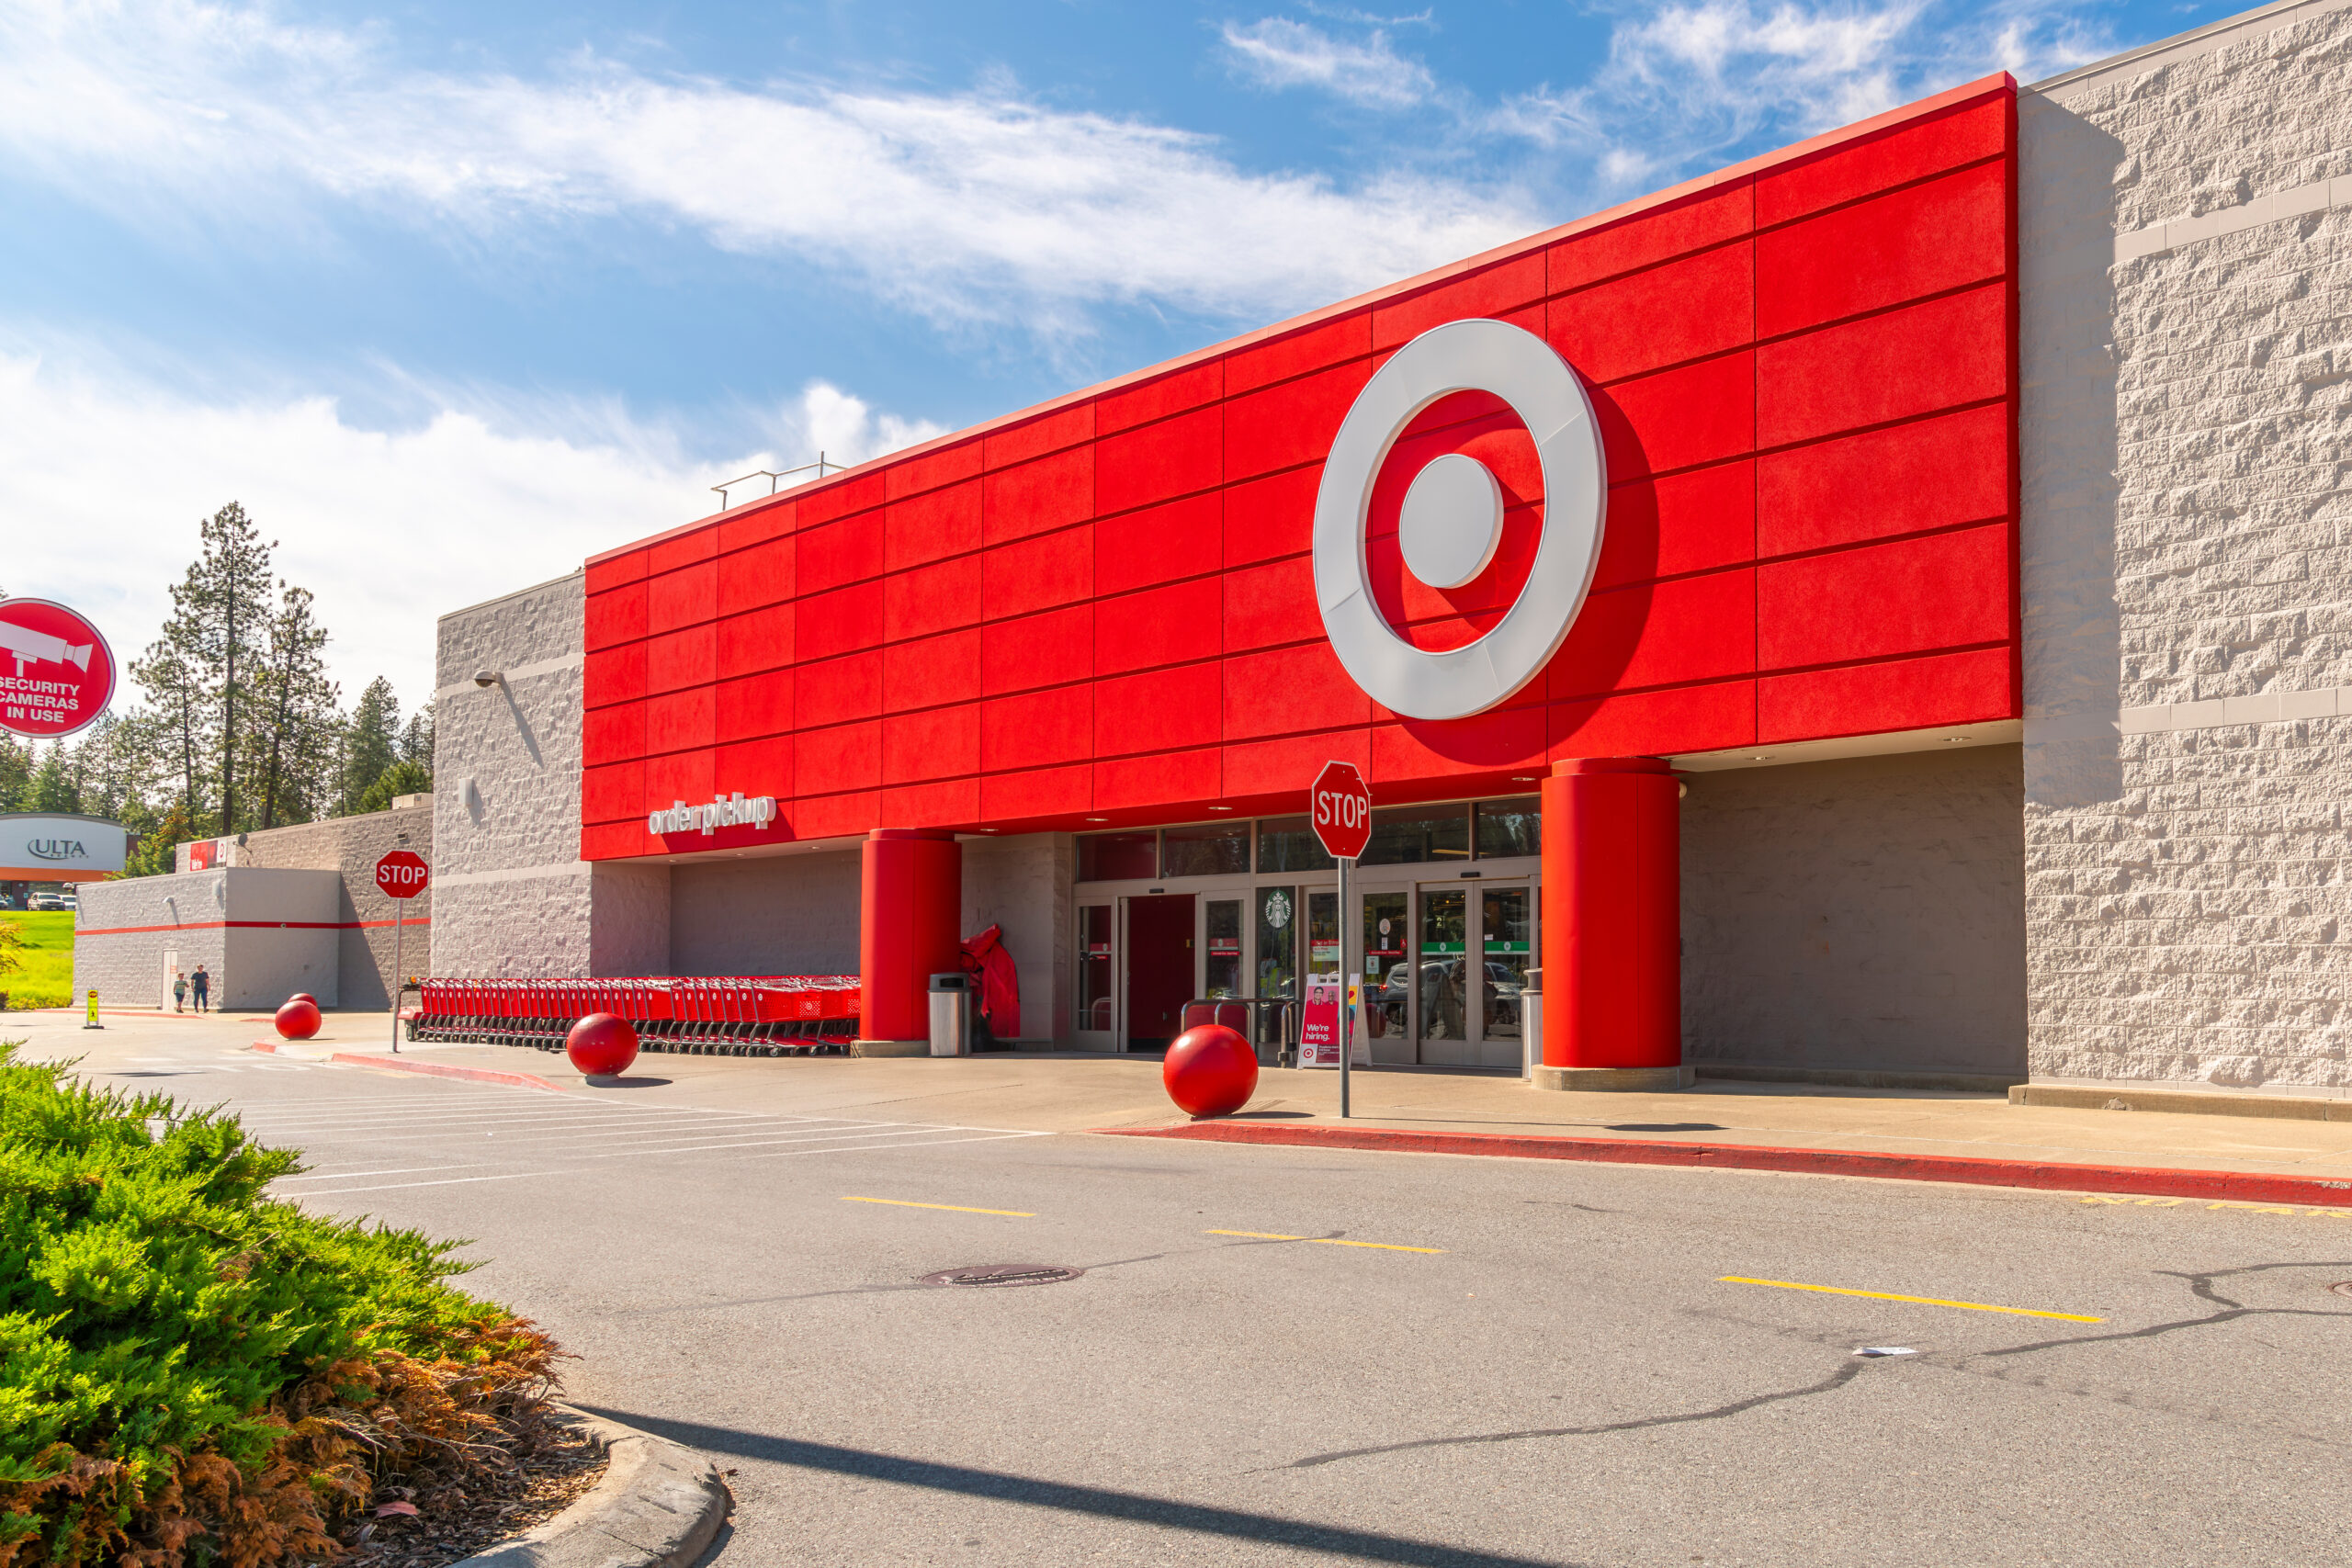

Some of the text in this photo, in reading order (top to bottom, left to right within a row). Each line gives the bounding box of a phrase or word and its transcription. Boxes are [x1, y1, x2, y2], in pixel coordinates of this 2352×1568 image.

[7, 706, 64, 723] IN USE
[649, 792, 776, 835] order pickup
[1317, 791, 1367, 829] STOP
[36, 840, 86, 854] ULTA
[379, 865, 425, 884] STOP
[1306, 1032, 1329, 1042] hiring.
